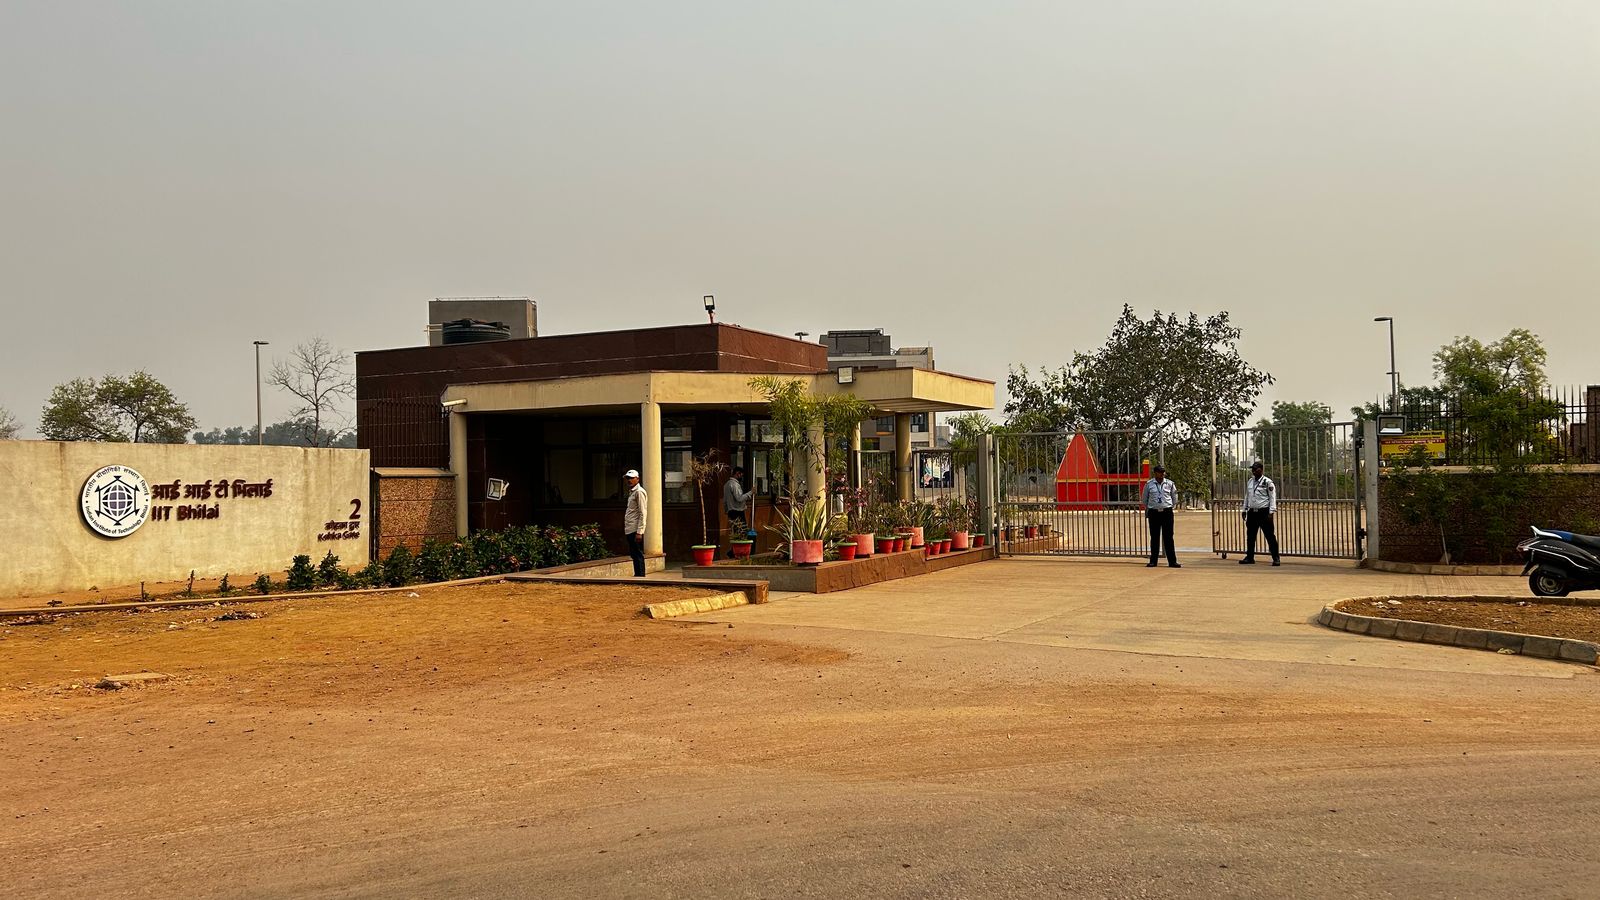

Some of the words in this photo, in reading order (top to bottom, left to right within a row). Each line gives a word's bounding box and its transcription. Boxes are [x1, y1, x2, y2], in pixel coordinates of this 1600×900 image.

[85, 479, 97, 498] भारतीय
[151, 479, 181, 500] आई
[184, 480, 212, 500] आई
[213, 479, 230, 499] टी
[231, 478, 273, 498] भिलाई
[151, 505, 173, 521] IIT
[177, 504, 220, 521] Bhilai
[349, 498, 362, 519] 2
[85, 506, 95, 521] Indian
[92, 520, 112, 534] Institute
[118, 519, 142, 534] Technology
[140, 505, 149, 519] Bhilai
[342, 530, 360, 540] Gate
